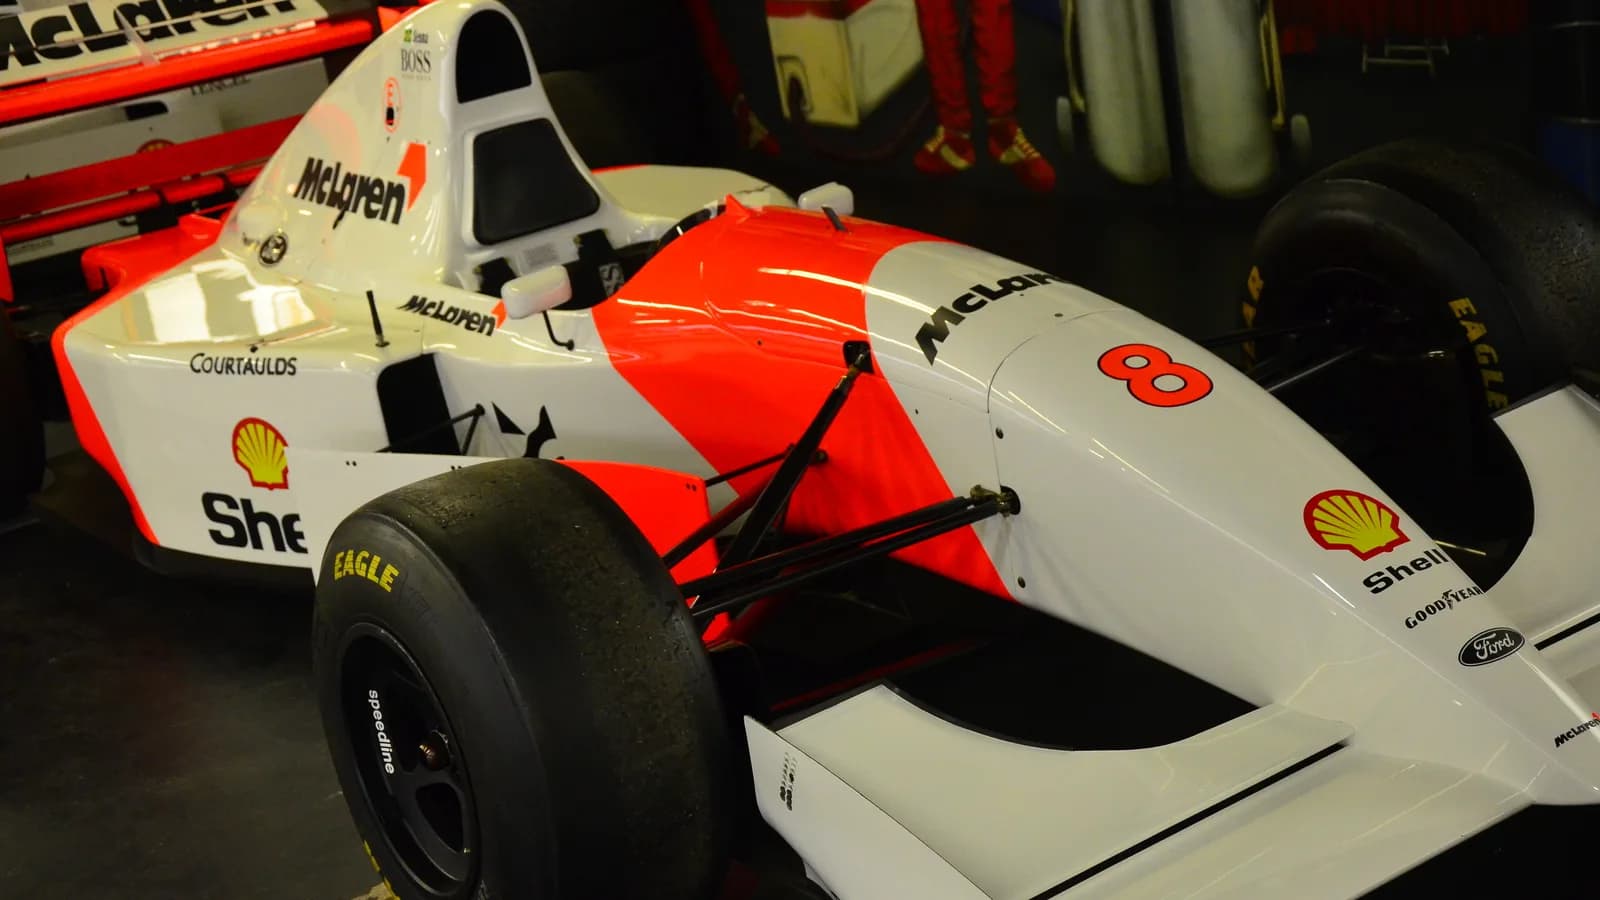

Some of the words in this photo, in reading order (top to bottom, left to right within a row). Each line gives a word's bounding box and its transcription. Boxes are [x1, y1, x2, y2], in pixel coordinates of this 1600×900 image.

[401, 48, 432, 74] BOSS
[293, 156, 405, 225] McLaren
[398, 295, 497, 337] McLaren
[190, 353, 297, 377] COURTAULDS
[1097, 343, 1214, 408] 8
[1448, 297, 1510, 409] EAGLE
[201, 492, 309, 554] She
[334, 549, 399, 593] EAGLE
[1362, 549, 1449, 595] Shell
[1473, 632, 1516, 660] Ford
[368, 689, 395, 775] speedline
